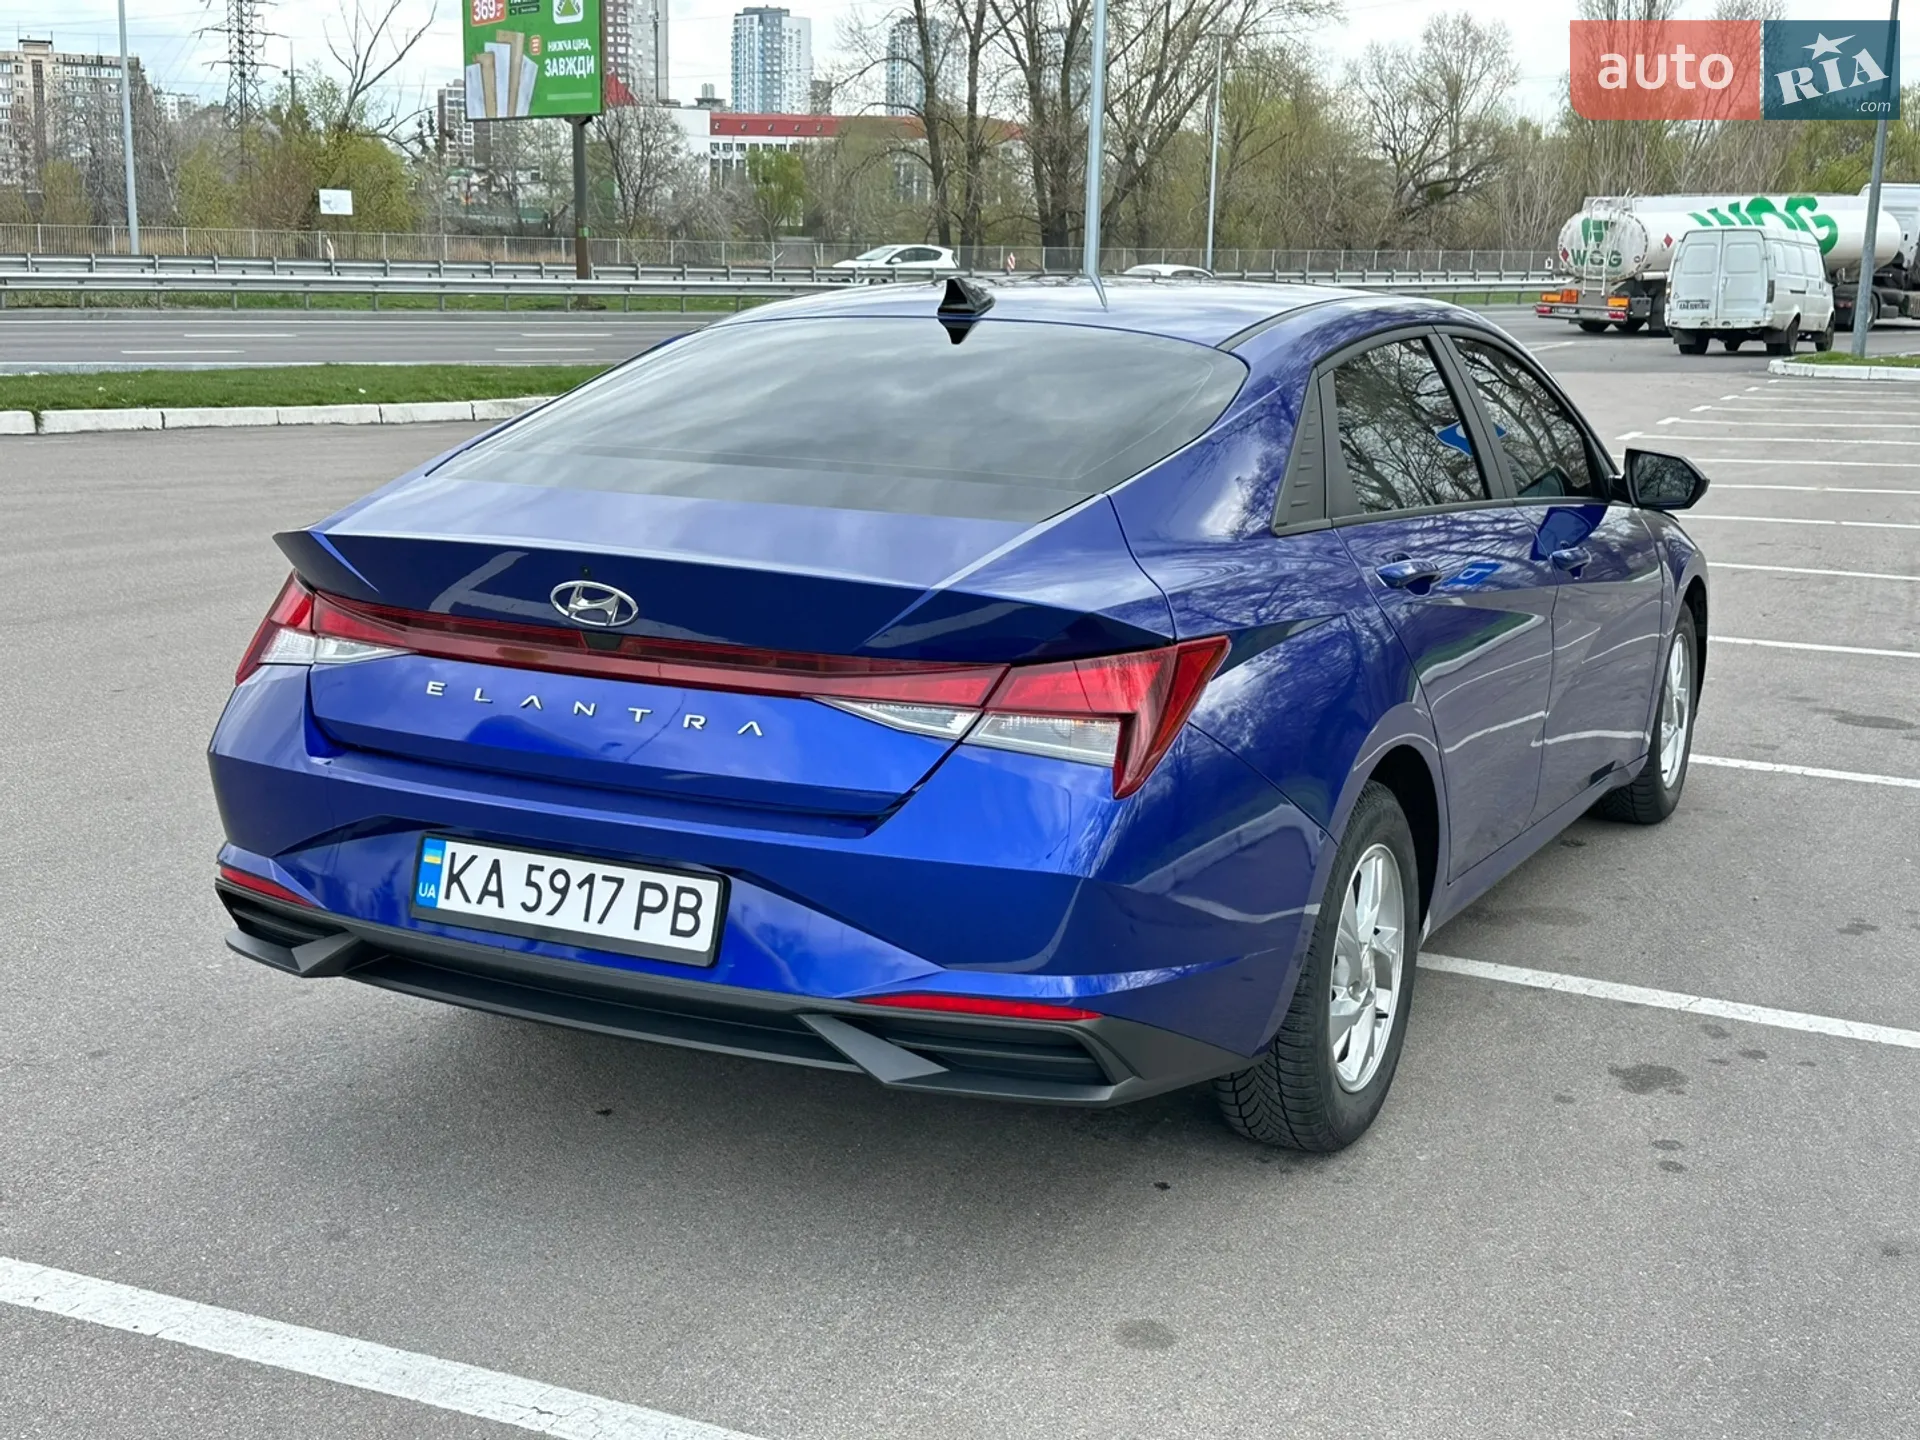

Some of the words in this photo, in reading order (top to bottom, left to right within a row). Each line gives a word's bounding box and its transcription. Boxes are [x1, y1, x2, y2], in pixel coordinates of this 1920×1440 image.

[473, 0, 496, 21] 369
[547, 40, 571, 52] НИЖЧА
[544, 55, 595, 79] ЗАВЖДИ
[1571, 249, 1623, 268] WOG
[425, 680, 764, 737] ELANTRA
[418, 882, 436, 899] UA
[444, 852, 504, 909] KA
[520, 863, 625, 925] 5917
[633, 880, 703, 939] PB
